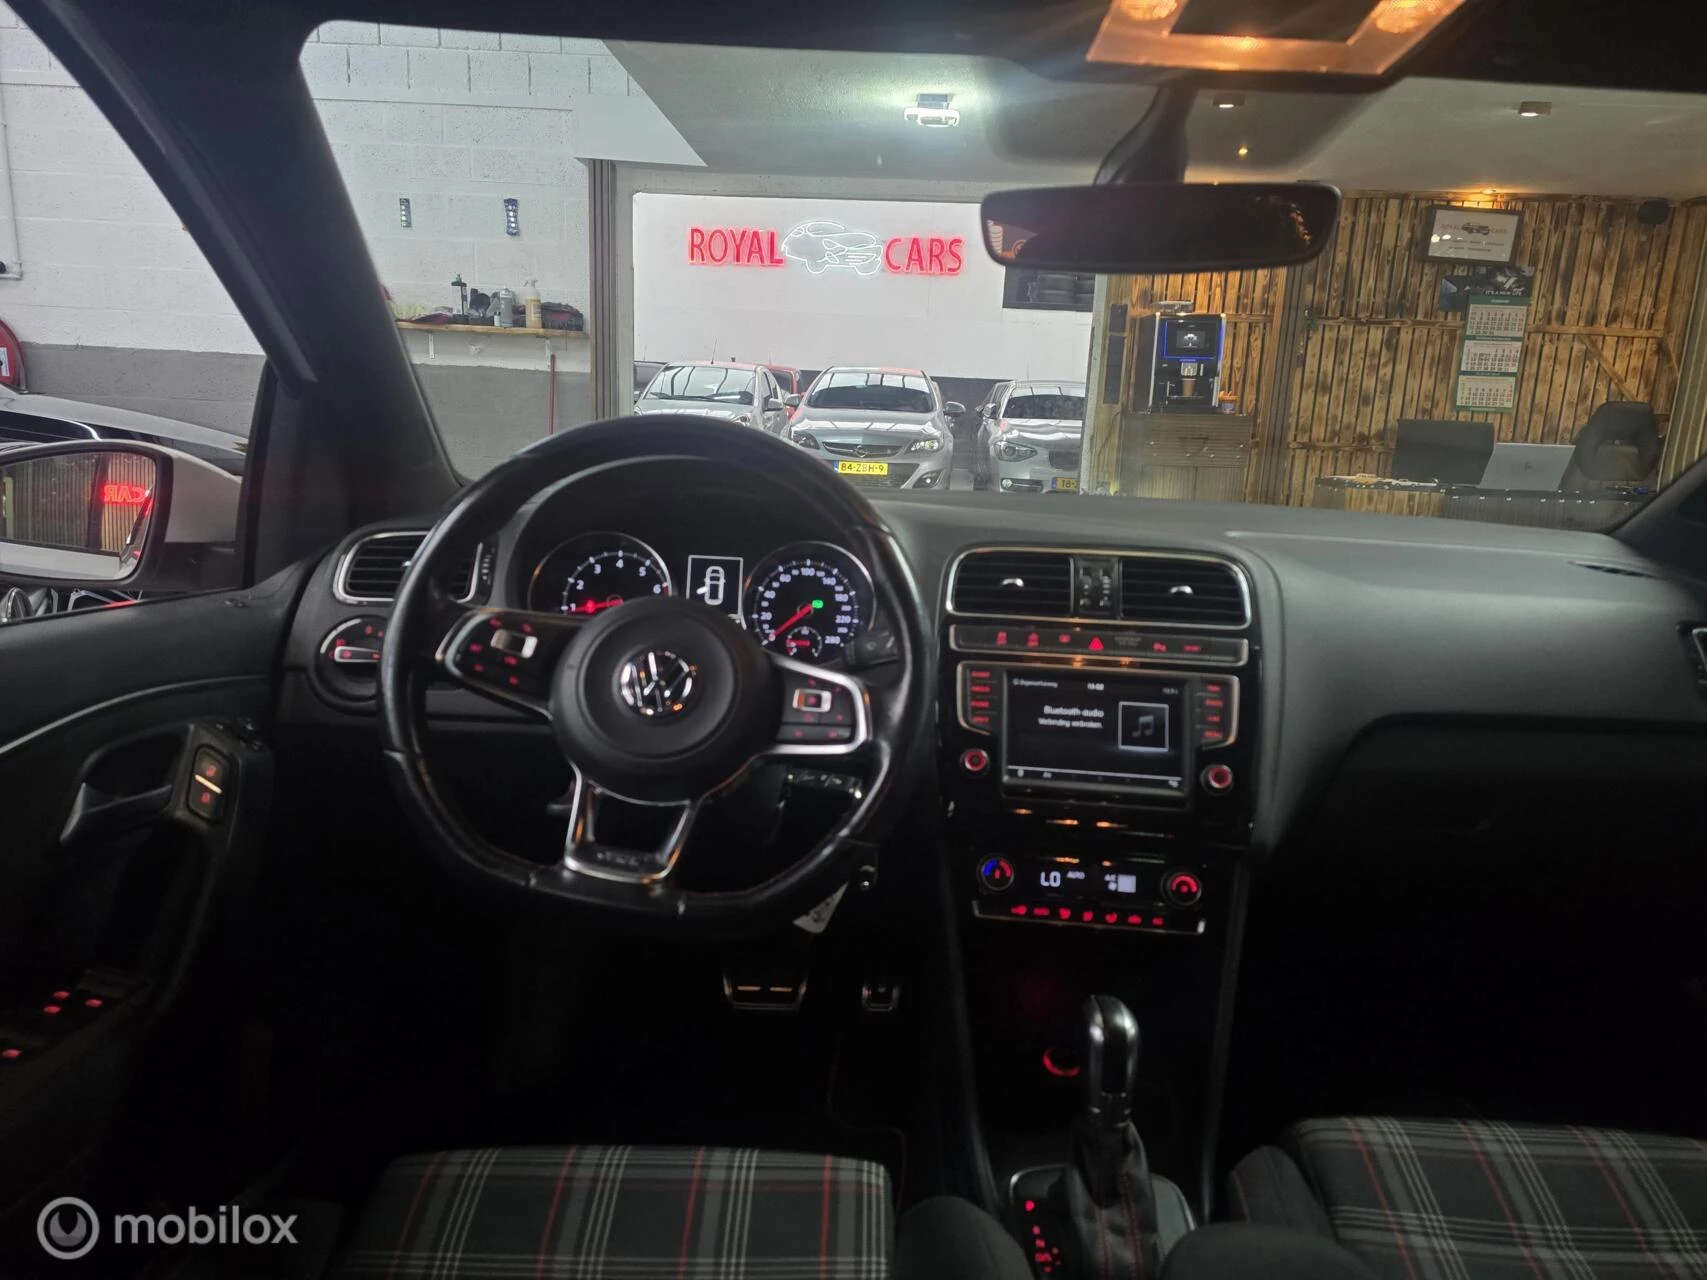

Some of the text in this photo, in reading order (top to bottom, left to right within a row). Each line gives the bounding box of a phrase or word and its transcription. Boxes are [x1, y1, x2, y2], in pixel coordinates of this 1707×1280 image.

[688, 227, 964, 274] ROYAL CARS
[841, 462, 885, 473] 84-ZBH-9
[616, 559, 624, 568] 4
[576, 580, 585, 590] 2
[1040, 871, 1061, 887] LO
